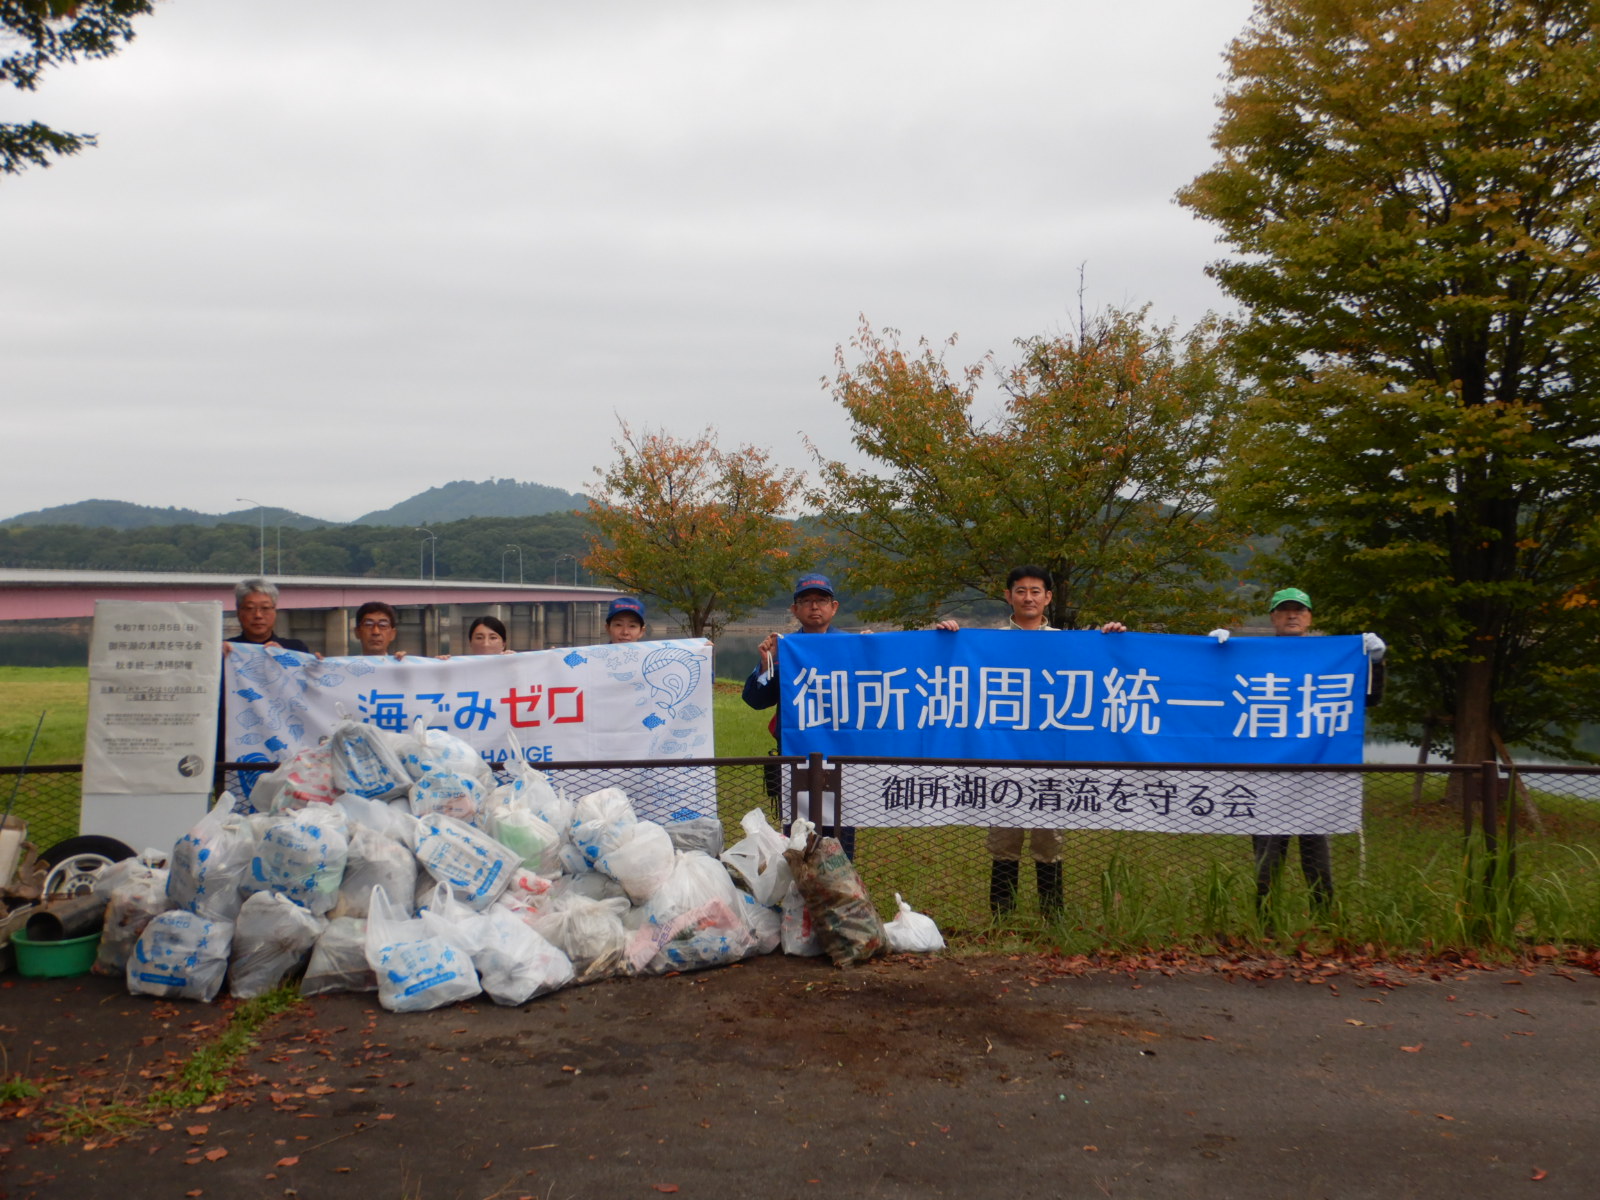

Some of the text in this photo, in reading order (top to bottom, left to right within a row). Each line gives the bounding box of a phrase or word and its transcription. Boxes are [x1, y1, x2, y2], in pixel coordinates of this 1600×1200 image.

[108, 641, 202, 650] 御所湖の清流を守る会
[357, 685, 585, 733] 海ごみゼロ
[792, 665, 1355, 739] 御所湖周辺統一清掃
[481, 745, 554, 763] HANGE
[880, 774, 1257, 819] 御所湖の清流を守る会
